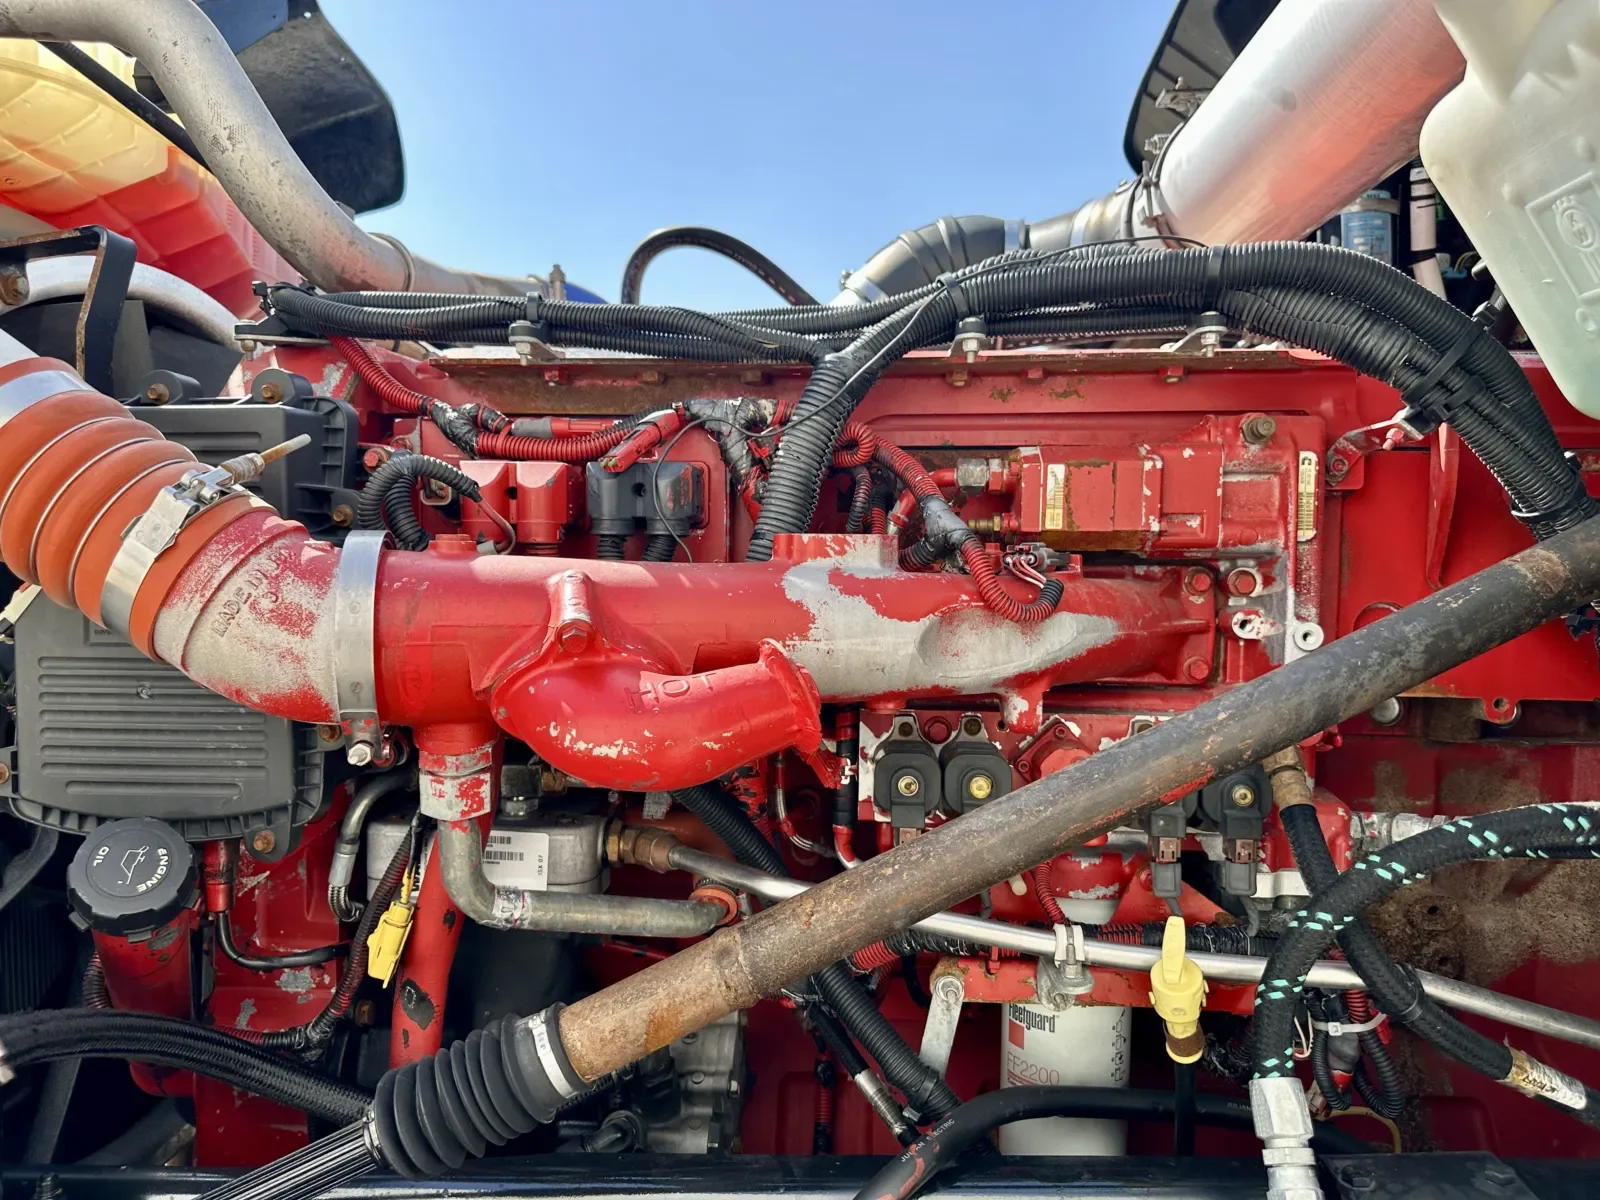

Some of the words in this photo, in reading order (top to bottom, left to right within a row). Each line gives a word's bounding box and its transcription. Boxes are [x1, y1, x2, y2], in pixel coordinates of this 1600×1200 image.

[623, 672, 717, 713] HOT
[93, 846, 110, 867] OIL
[136, 847, 169, 892] ENGINE
[1007, 1050, 1060, 1086] FF2200
[925, 1118, 955, 1141] EECTRIC
